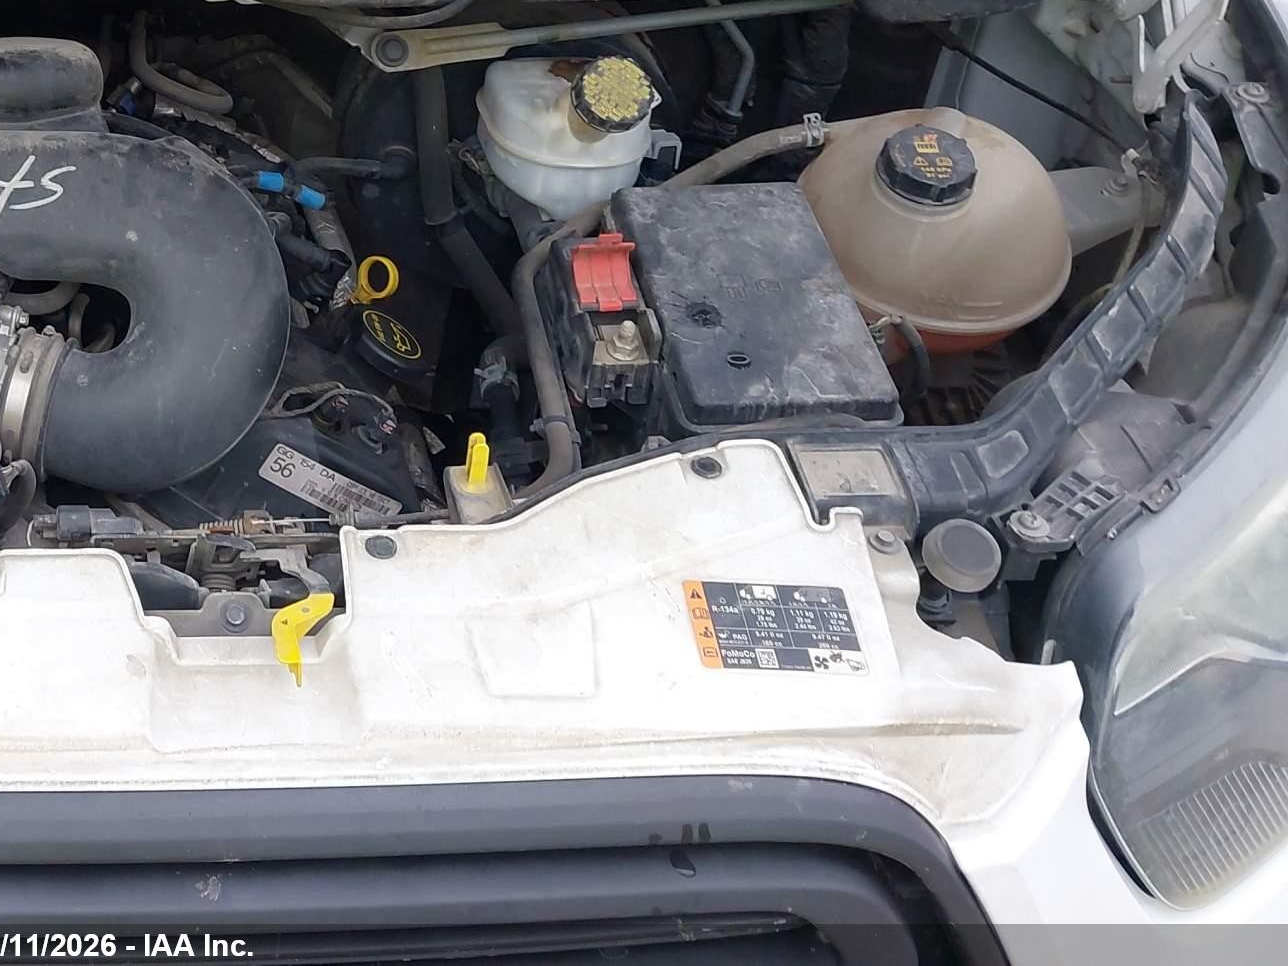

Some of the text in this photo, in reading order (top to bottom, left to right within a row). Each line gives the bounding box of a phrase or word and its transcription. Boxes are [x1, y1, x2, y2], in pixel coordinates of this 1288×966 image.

[270, 457, 296, 479] 56
[319, 469, 336, 482] DA
[711, 606, 740, 614] R-134a
[721, 649, 756, 658] FoMoCo
